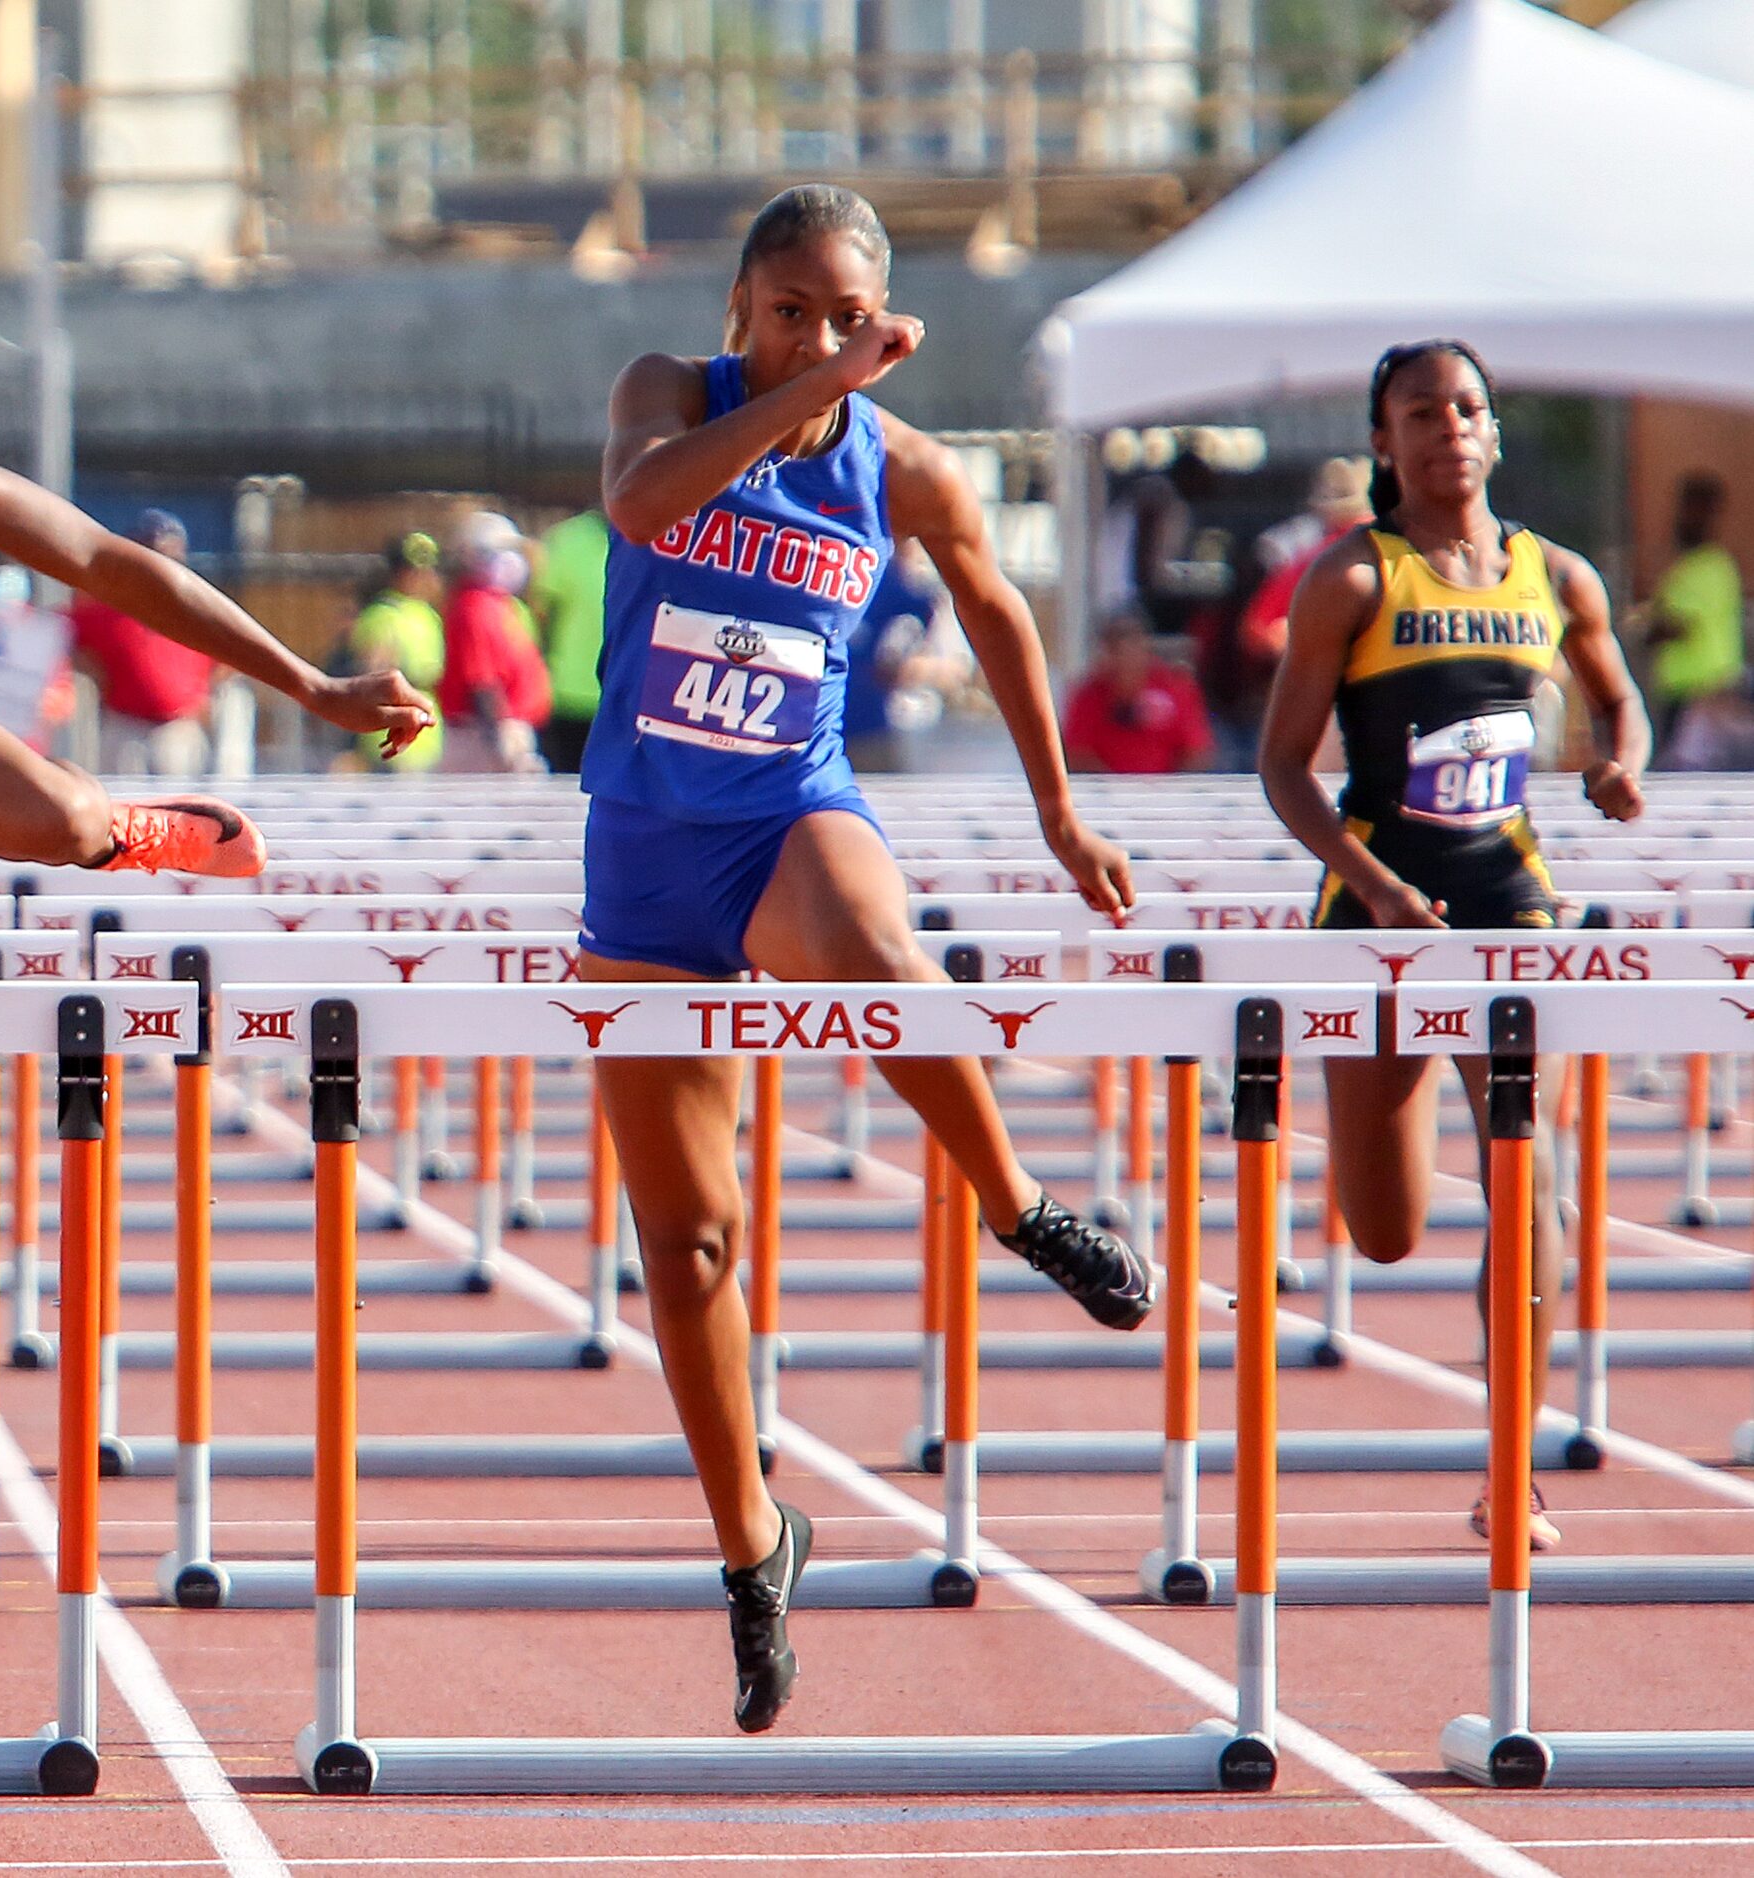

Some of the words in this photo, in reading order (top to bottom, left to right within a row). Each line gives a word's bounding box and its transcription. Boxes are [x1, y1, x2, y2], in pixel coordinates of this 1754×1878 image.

[715, 632, 766, 652] STATE
[1394, 608, 1551, 647] BRENNAN
[673, 660, 785, 737] 442
[709, 733, 735, 747] 2021
[1433, 757, 1508, 812] 941
[359, 907, 511, 931] TEXAS
[1188, 906, 1308, 928] TEXA
[17, 952, 64, 976] XII
[110, 954, 158, 978] XII
[485, 947, 581, 982] TEX
[998, 954, 1046, 978] XII
[1107, 951, 1154, 976] XII
[1474, 945, 1651, 980] TEXAS
[123, 1008, 182, 1038] XII
[237, 1010, 296, 1040] XII
[688, 1001, 902, 1050] TEXAS
[1302, 1009, 1360, 1040] XII
[1413, 1007, 1472, 1038] XII
